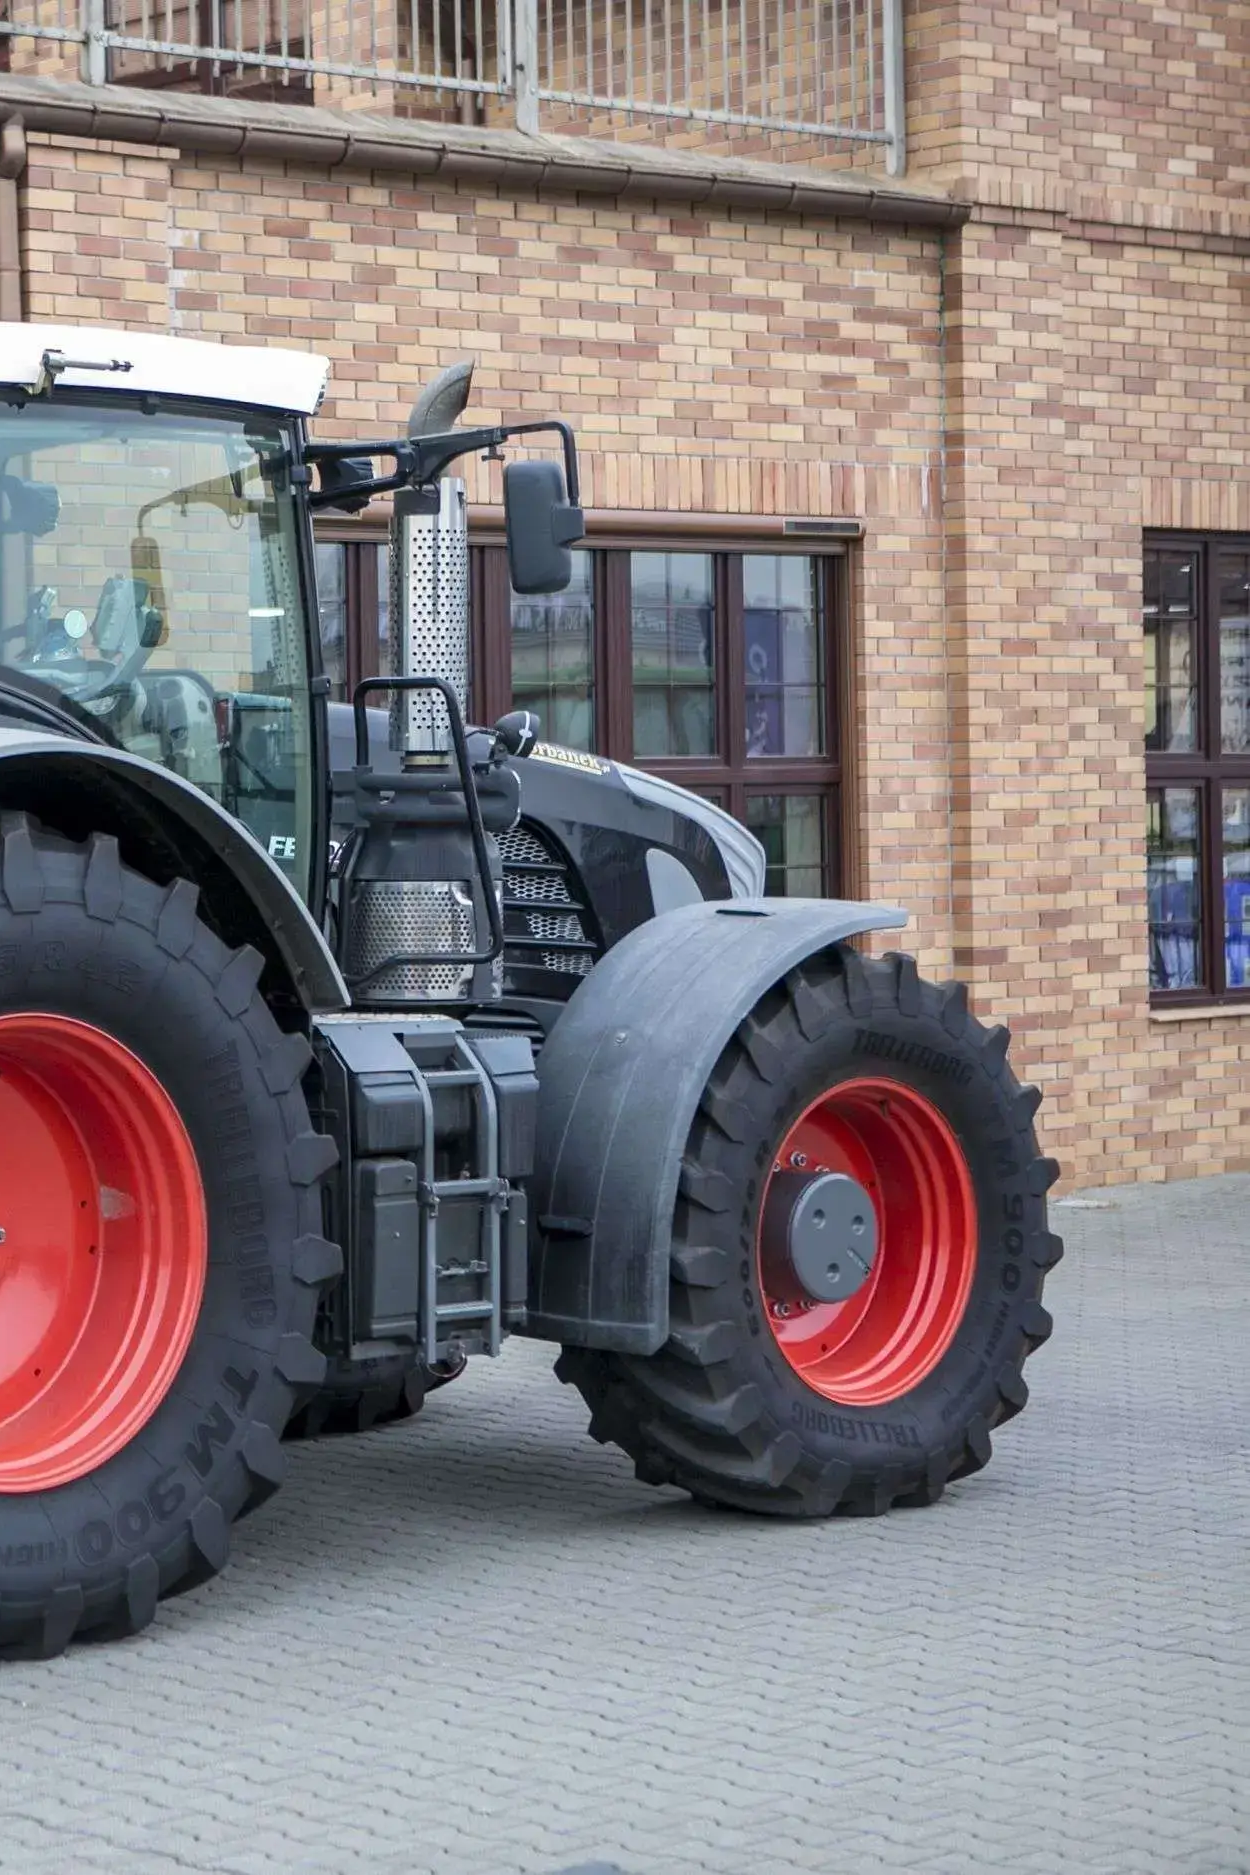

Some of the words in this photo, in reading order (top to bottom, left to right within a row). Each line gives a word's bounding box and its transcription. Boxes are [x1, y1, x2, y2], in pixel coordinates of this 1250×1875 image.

[852, 1027, 975, 1087] TRELLEBORG
[206, 1038, 278, 1330] TRELLEBORG
[999, 1190, 1024, 1294] 900
[184, 1364, 259, 1480] TM
[75, 1463, 190, 1568] 900
